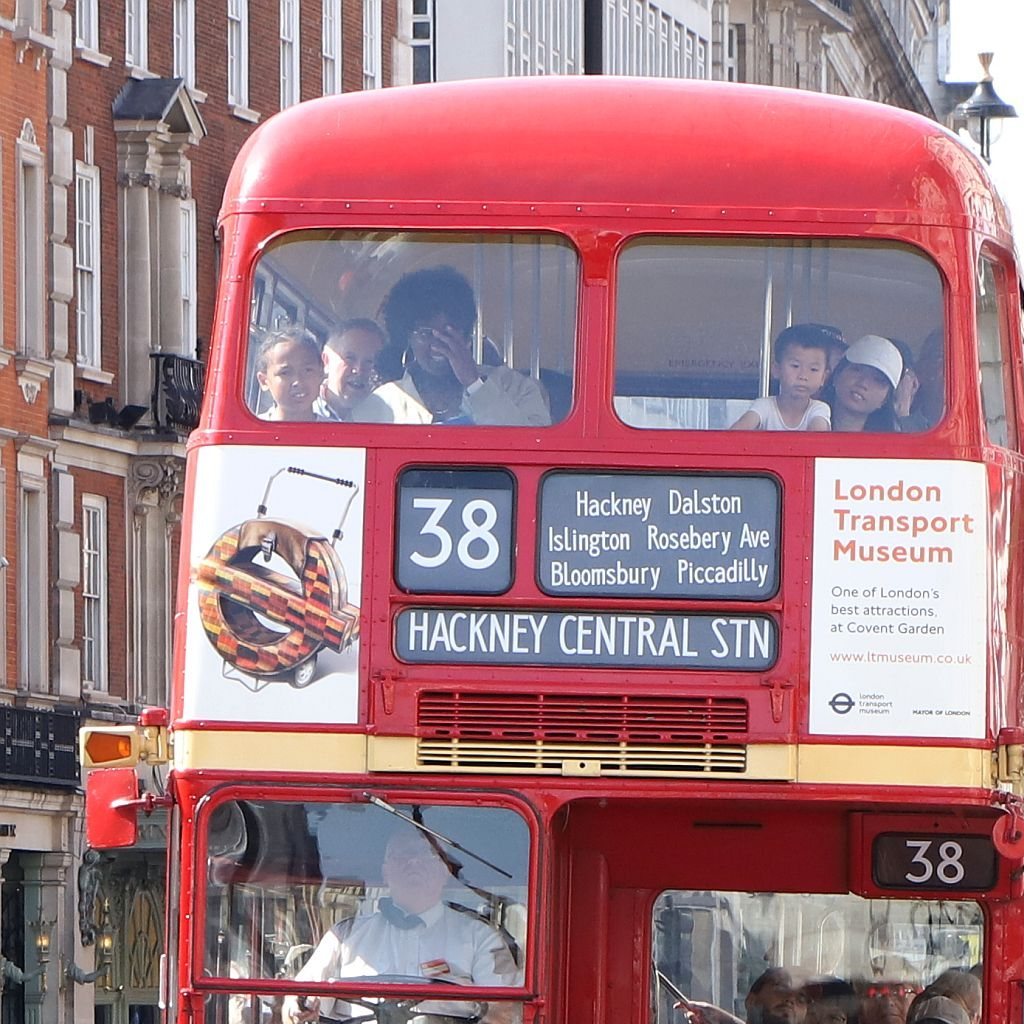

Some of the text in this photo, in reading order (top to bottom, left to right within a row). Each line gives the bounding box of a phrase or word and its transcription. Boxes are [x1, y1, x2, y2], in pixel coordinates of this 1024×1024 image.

[834, 479, 941, 502] London
[576, 489, 741, 522] Hackney Dalston
[409, 498, 499, 569] 38
[833, 509, 974, 537] Transport
[548, 523, 770, 557] Islington Rosebery Ave
[833, 539, 953, 563] Museum
[551, 558, 768, 591] Bloomsbury Piccadilly
[831, 586, 940, 599] One of London's
[831, 604, 938, 618] best attractions,
[409, 612, 770, 659] HACKNEY CENTRAL STN
[830, 622, 945, 635] at Covent Garden
[830, 651, 973, 664] www.ltmuseum.co.uk
[905, 840, 965, 884] 38
